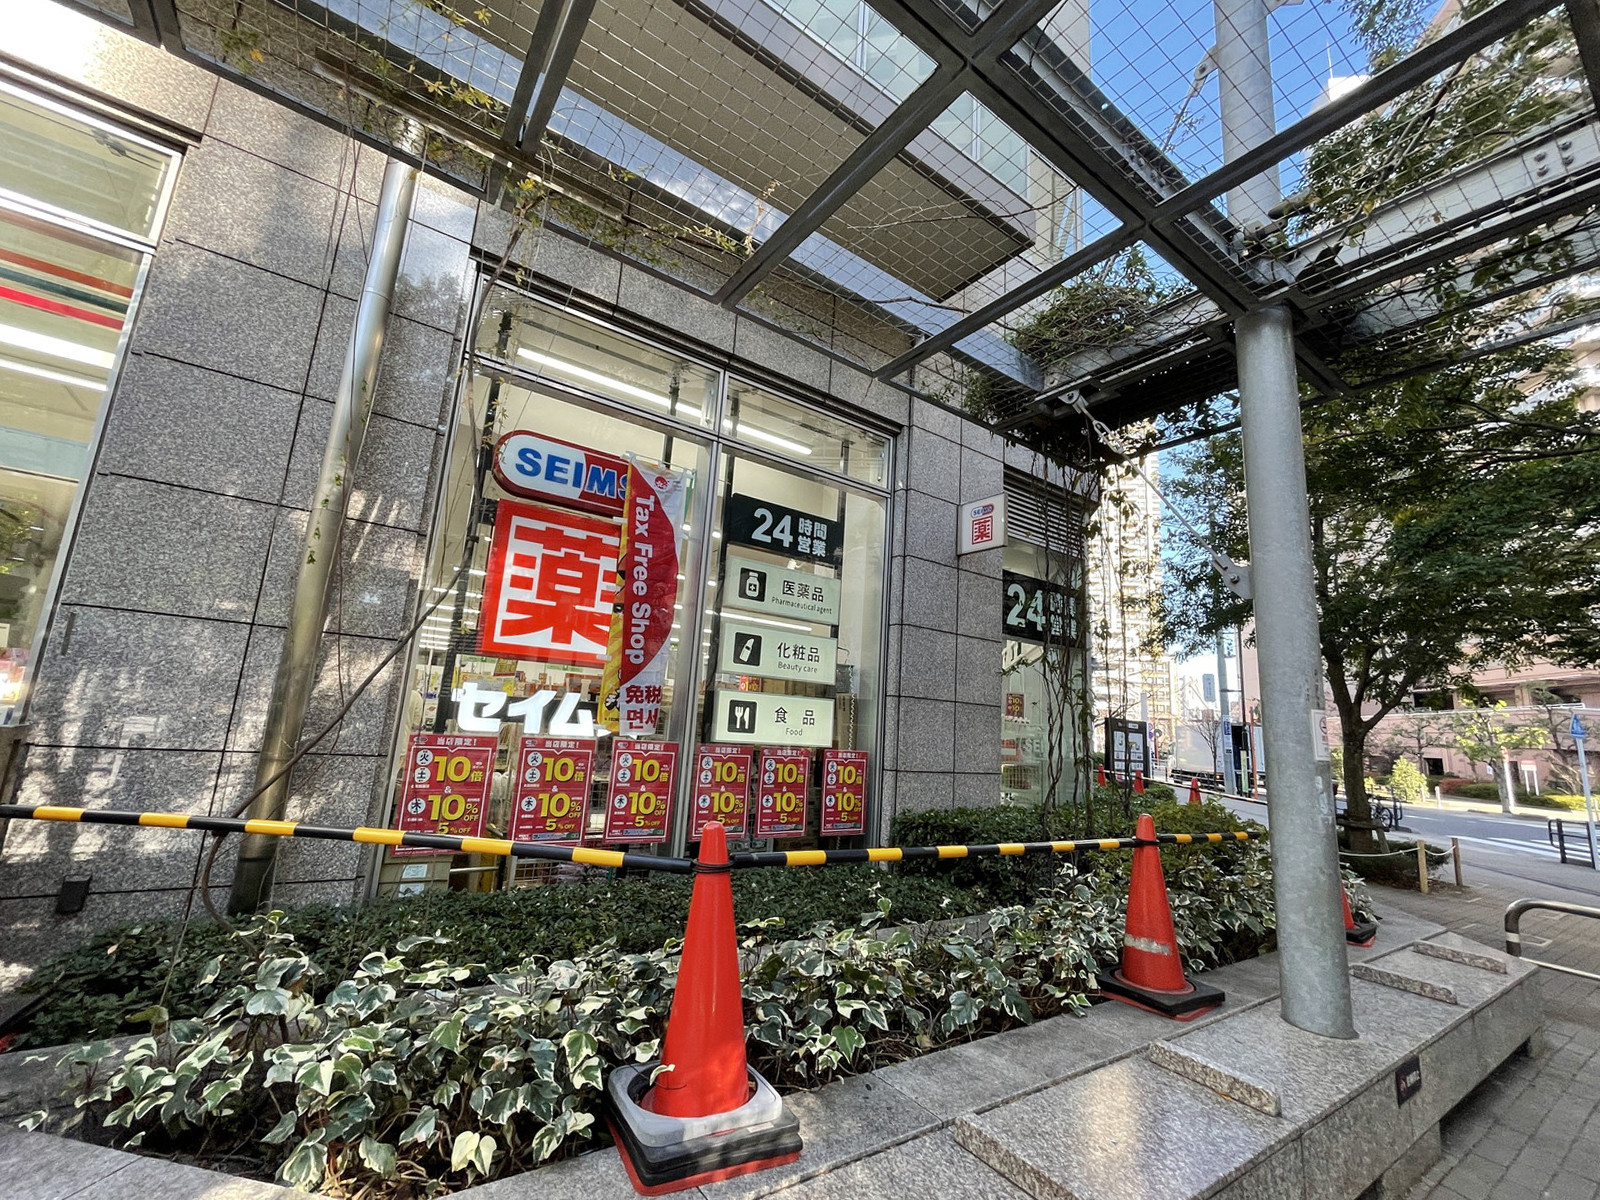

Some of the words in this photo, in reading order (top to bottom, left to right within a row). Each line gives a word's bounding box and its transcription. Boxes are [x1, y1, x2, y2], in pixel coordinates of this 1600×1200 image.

[634, 495, 655, 539] Tax
[752, 508, 793, 548] 24
[798, 518, 827, 540] 時間
[973, 519, 992, 542] 薬
[798, 536, 826, 557] 営業
[632, 542, 653, 597] Free
[497, 517, 620, 653] 薬
[782, 580, 824, 603] 医薬品
[771, 596, 816, 611] Pharmaceutical
[816, 606, 832, 614] agent
[1006, 583, 1046, 631] 24
[625, 602, 651, 666] Shop
[777, 642, 820, 663] 化粧品
[778, 661, 802, 673] Beauty
[803, 665, 818, 673] care
[626, 685, 661, 704] 免税
[451, 682, 616, 738] セイム
[775, 706, 815, 726] 食品
[437, 737, 476, 746] 当店限定！
[785, 728, 803, 736] Food
[420, 754, 429, 762] 火
[530, 755, 539, 763] 火
[417, 771, 426, 779] 土
[528, 771, 537, 779] 土
[444, 786, 452, 794] &
[524, 799, 533, 808] 木
